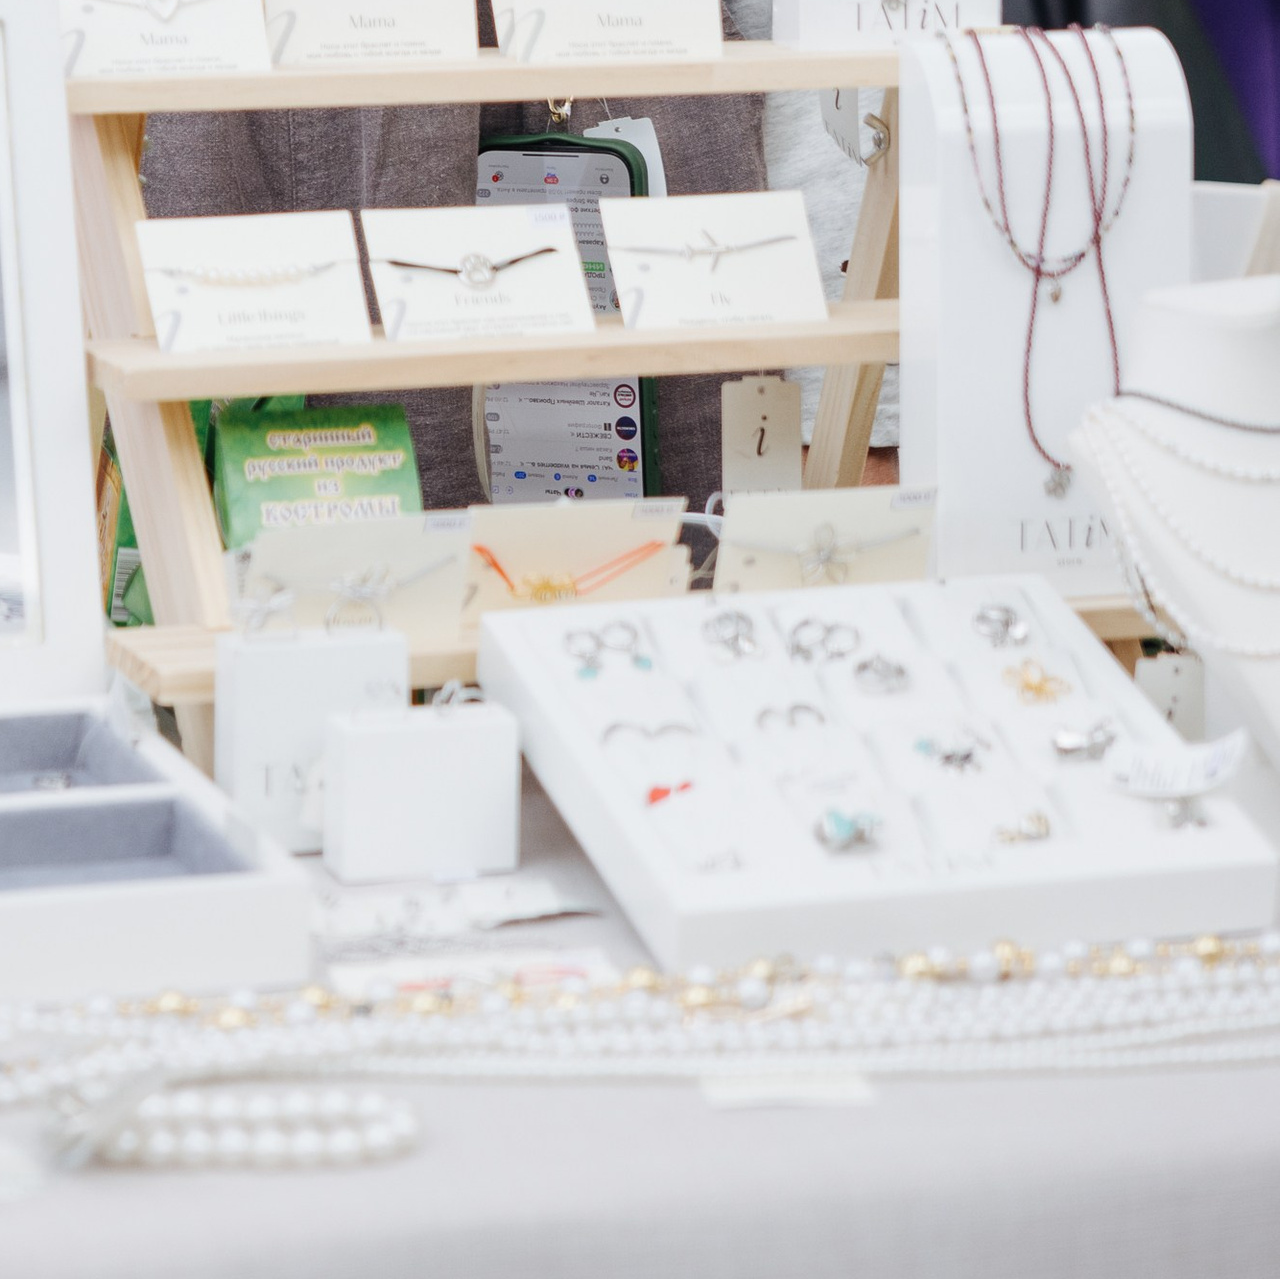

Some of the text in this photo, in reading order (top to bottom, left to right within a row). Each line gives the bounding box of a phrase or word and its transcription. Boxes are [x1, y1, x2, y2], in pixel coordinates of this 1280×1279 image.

[348, 14, 396, 29] Mama
[596, 12, 643, 28] Mama
[139, 31, 189, 46] Mama
